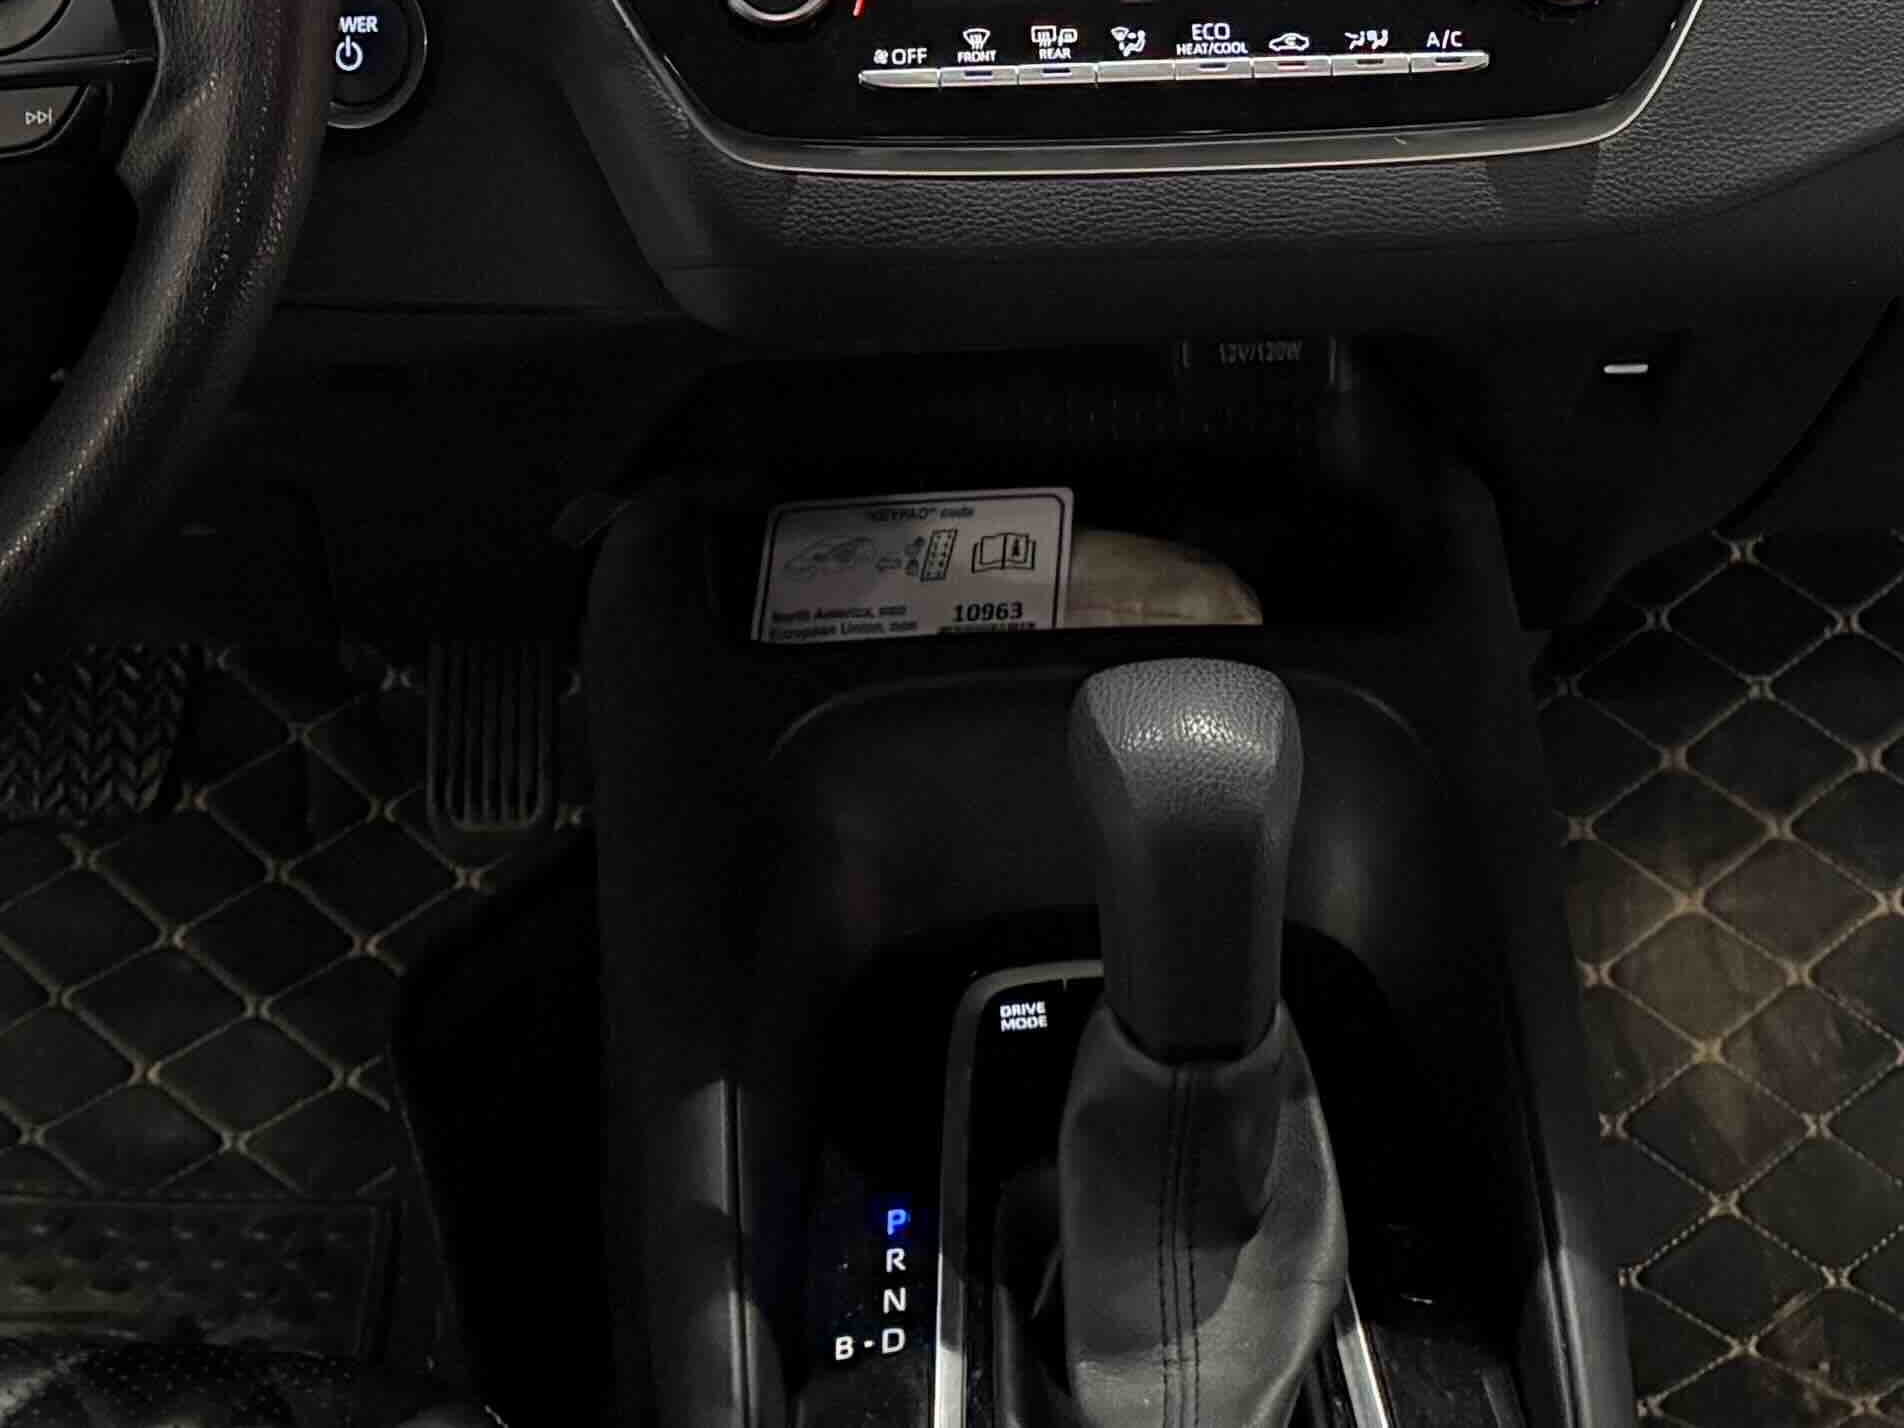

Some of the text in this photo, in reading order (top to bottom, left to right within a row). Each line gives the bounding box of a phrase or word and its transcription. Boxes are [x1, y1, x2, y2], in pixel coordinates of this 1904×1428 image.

[338, 15, 379, 34] WER
[1190, 22, 1231, 42] ECO
[1176, 41, 1249, 55] HEAT/COOL
[1426, 30, 1463, 49] A/C
[891, 47, 928, 65] OFF
[957, 49, 997, 64] FRONT
[1038, 47, 1072, 60] REAR
[953, 601, 1024, 623] 10963
[999, 1000, 1046, 1018] DRIVE
[1000, 1015, 1048, 1033] MODE
[886, 1208, 908, 1236] P
[885, 1247, 907, 1273] R
[883, 1287, 907, 1314] N
[834, 1327, 906, 1361] B D
